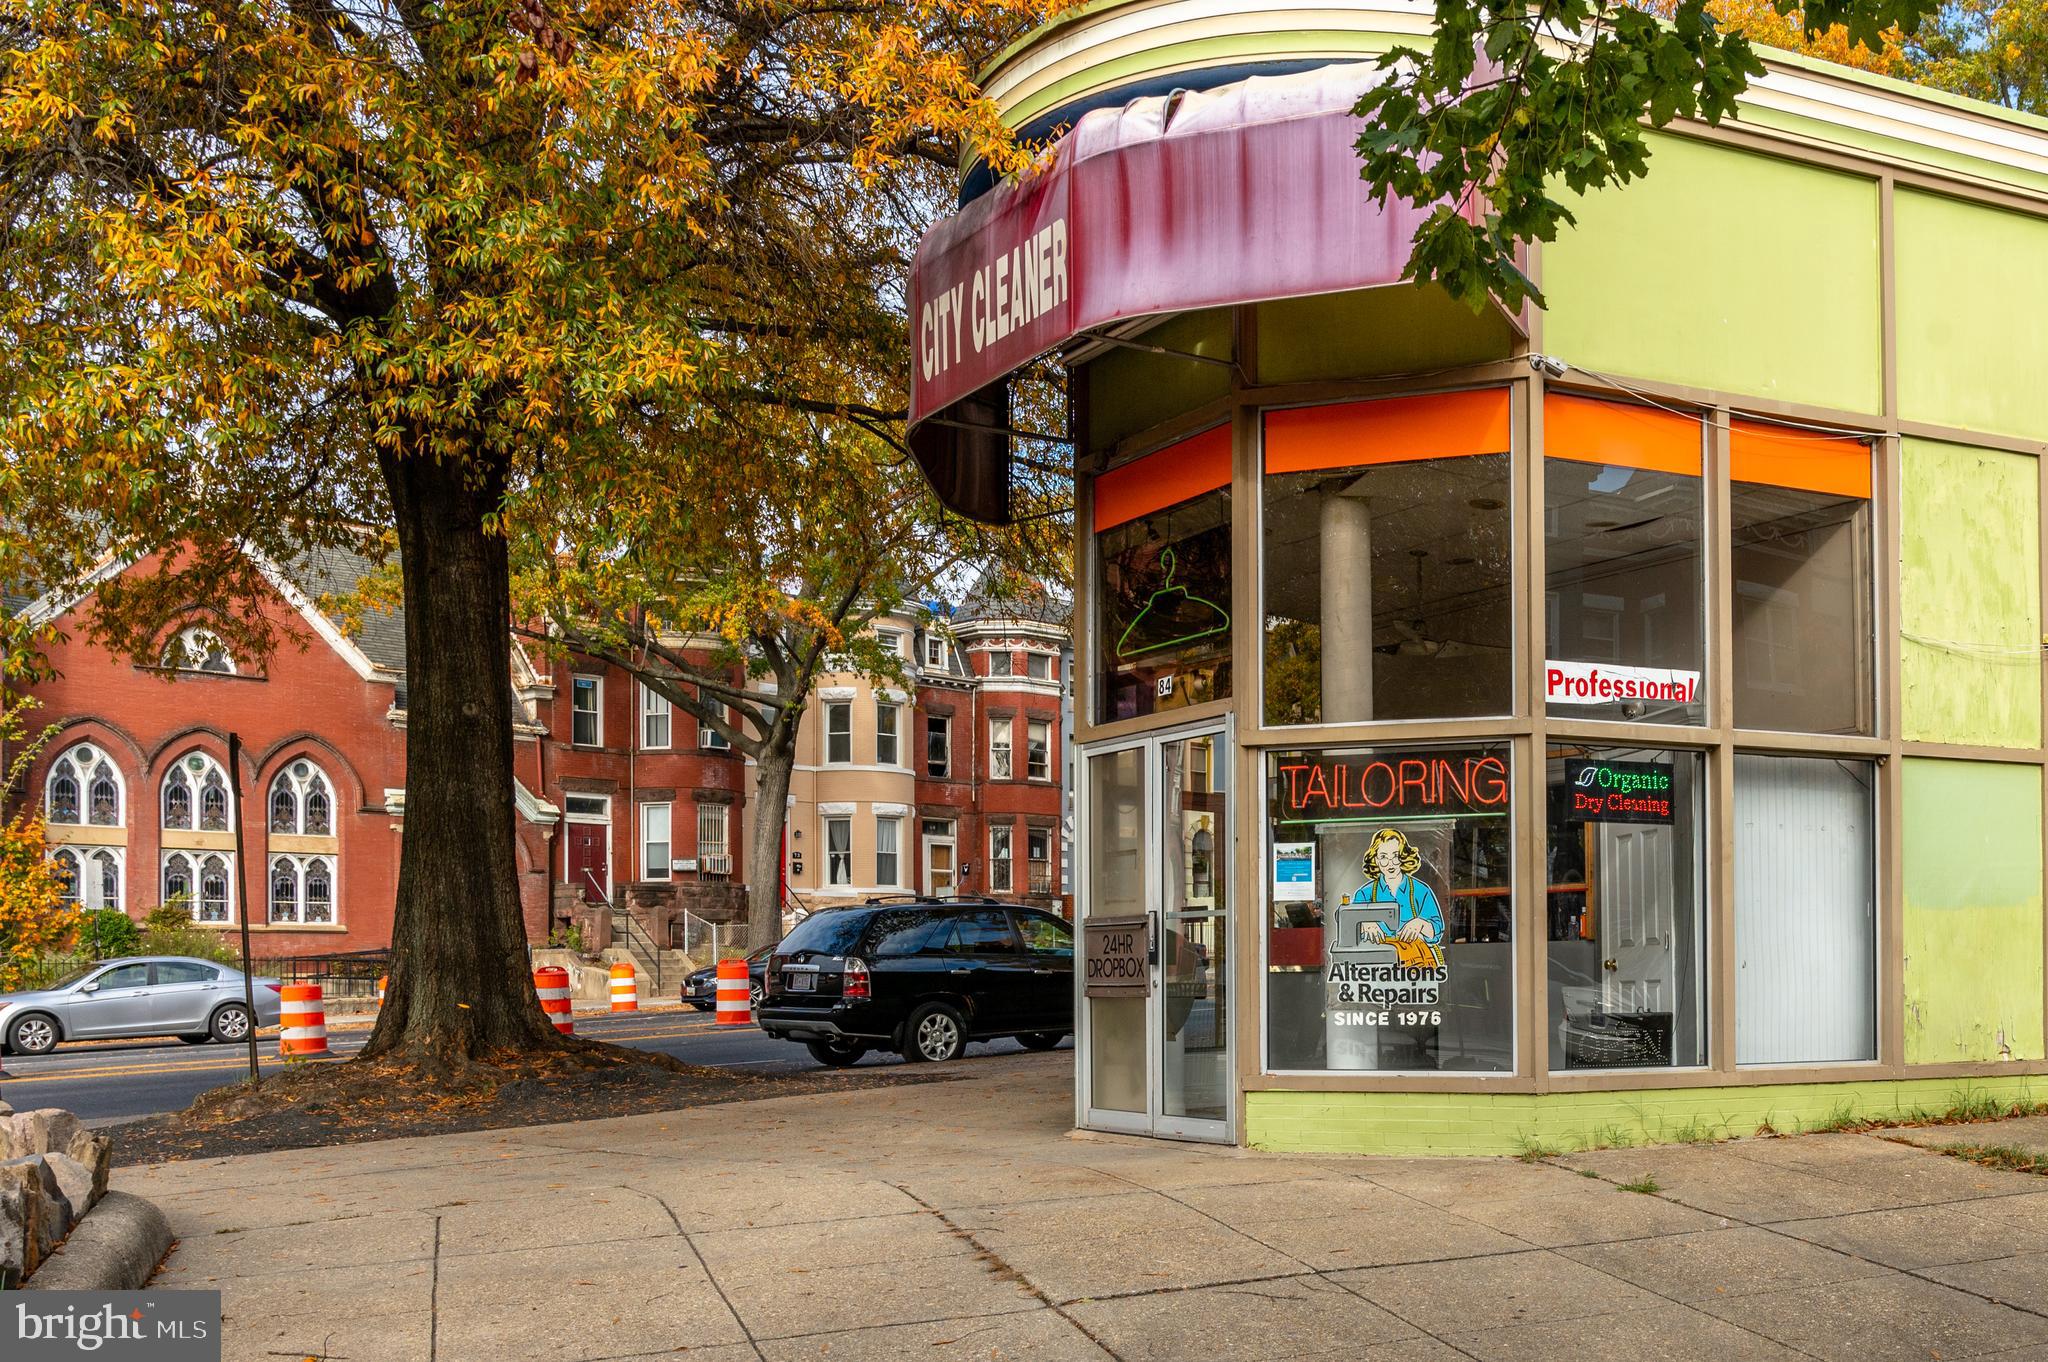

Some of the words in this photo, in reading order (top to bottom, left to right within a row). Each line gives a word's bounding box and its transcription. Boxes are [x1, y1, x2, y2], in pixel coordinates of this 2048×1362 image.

[921, 282, 964, 382] CITY
[971, 218, 1068, 354] CLEANER
[1158, 678, 1171, 694] 84
[1547, 669, 1694, 703] Professional
[1280, 757, 1508, 809] TAILORING
[1598, 767, 1669, 794] Organic
[1575, 793, 1604, 814] Dry
[1606, 794, 1670, 816] Cleaning
[1103, 934, 1133, 954] 24HR
[1088, 957, 1145, 978] DROPBOX
[1328, 961, 1447, 982] Alterations
[1339, 984, 1354, 1002] &
[1359, 982, 1438, 1009] Repairs
[1334, 1011, 1389, 1026] SINCE
[1398, 1011, 1441, 1026] 1976
